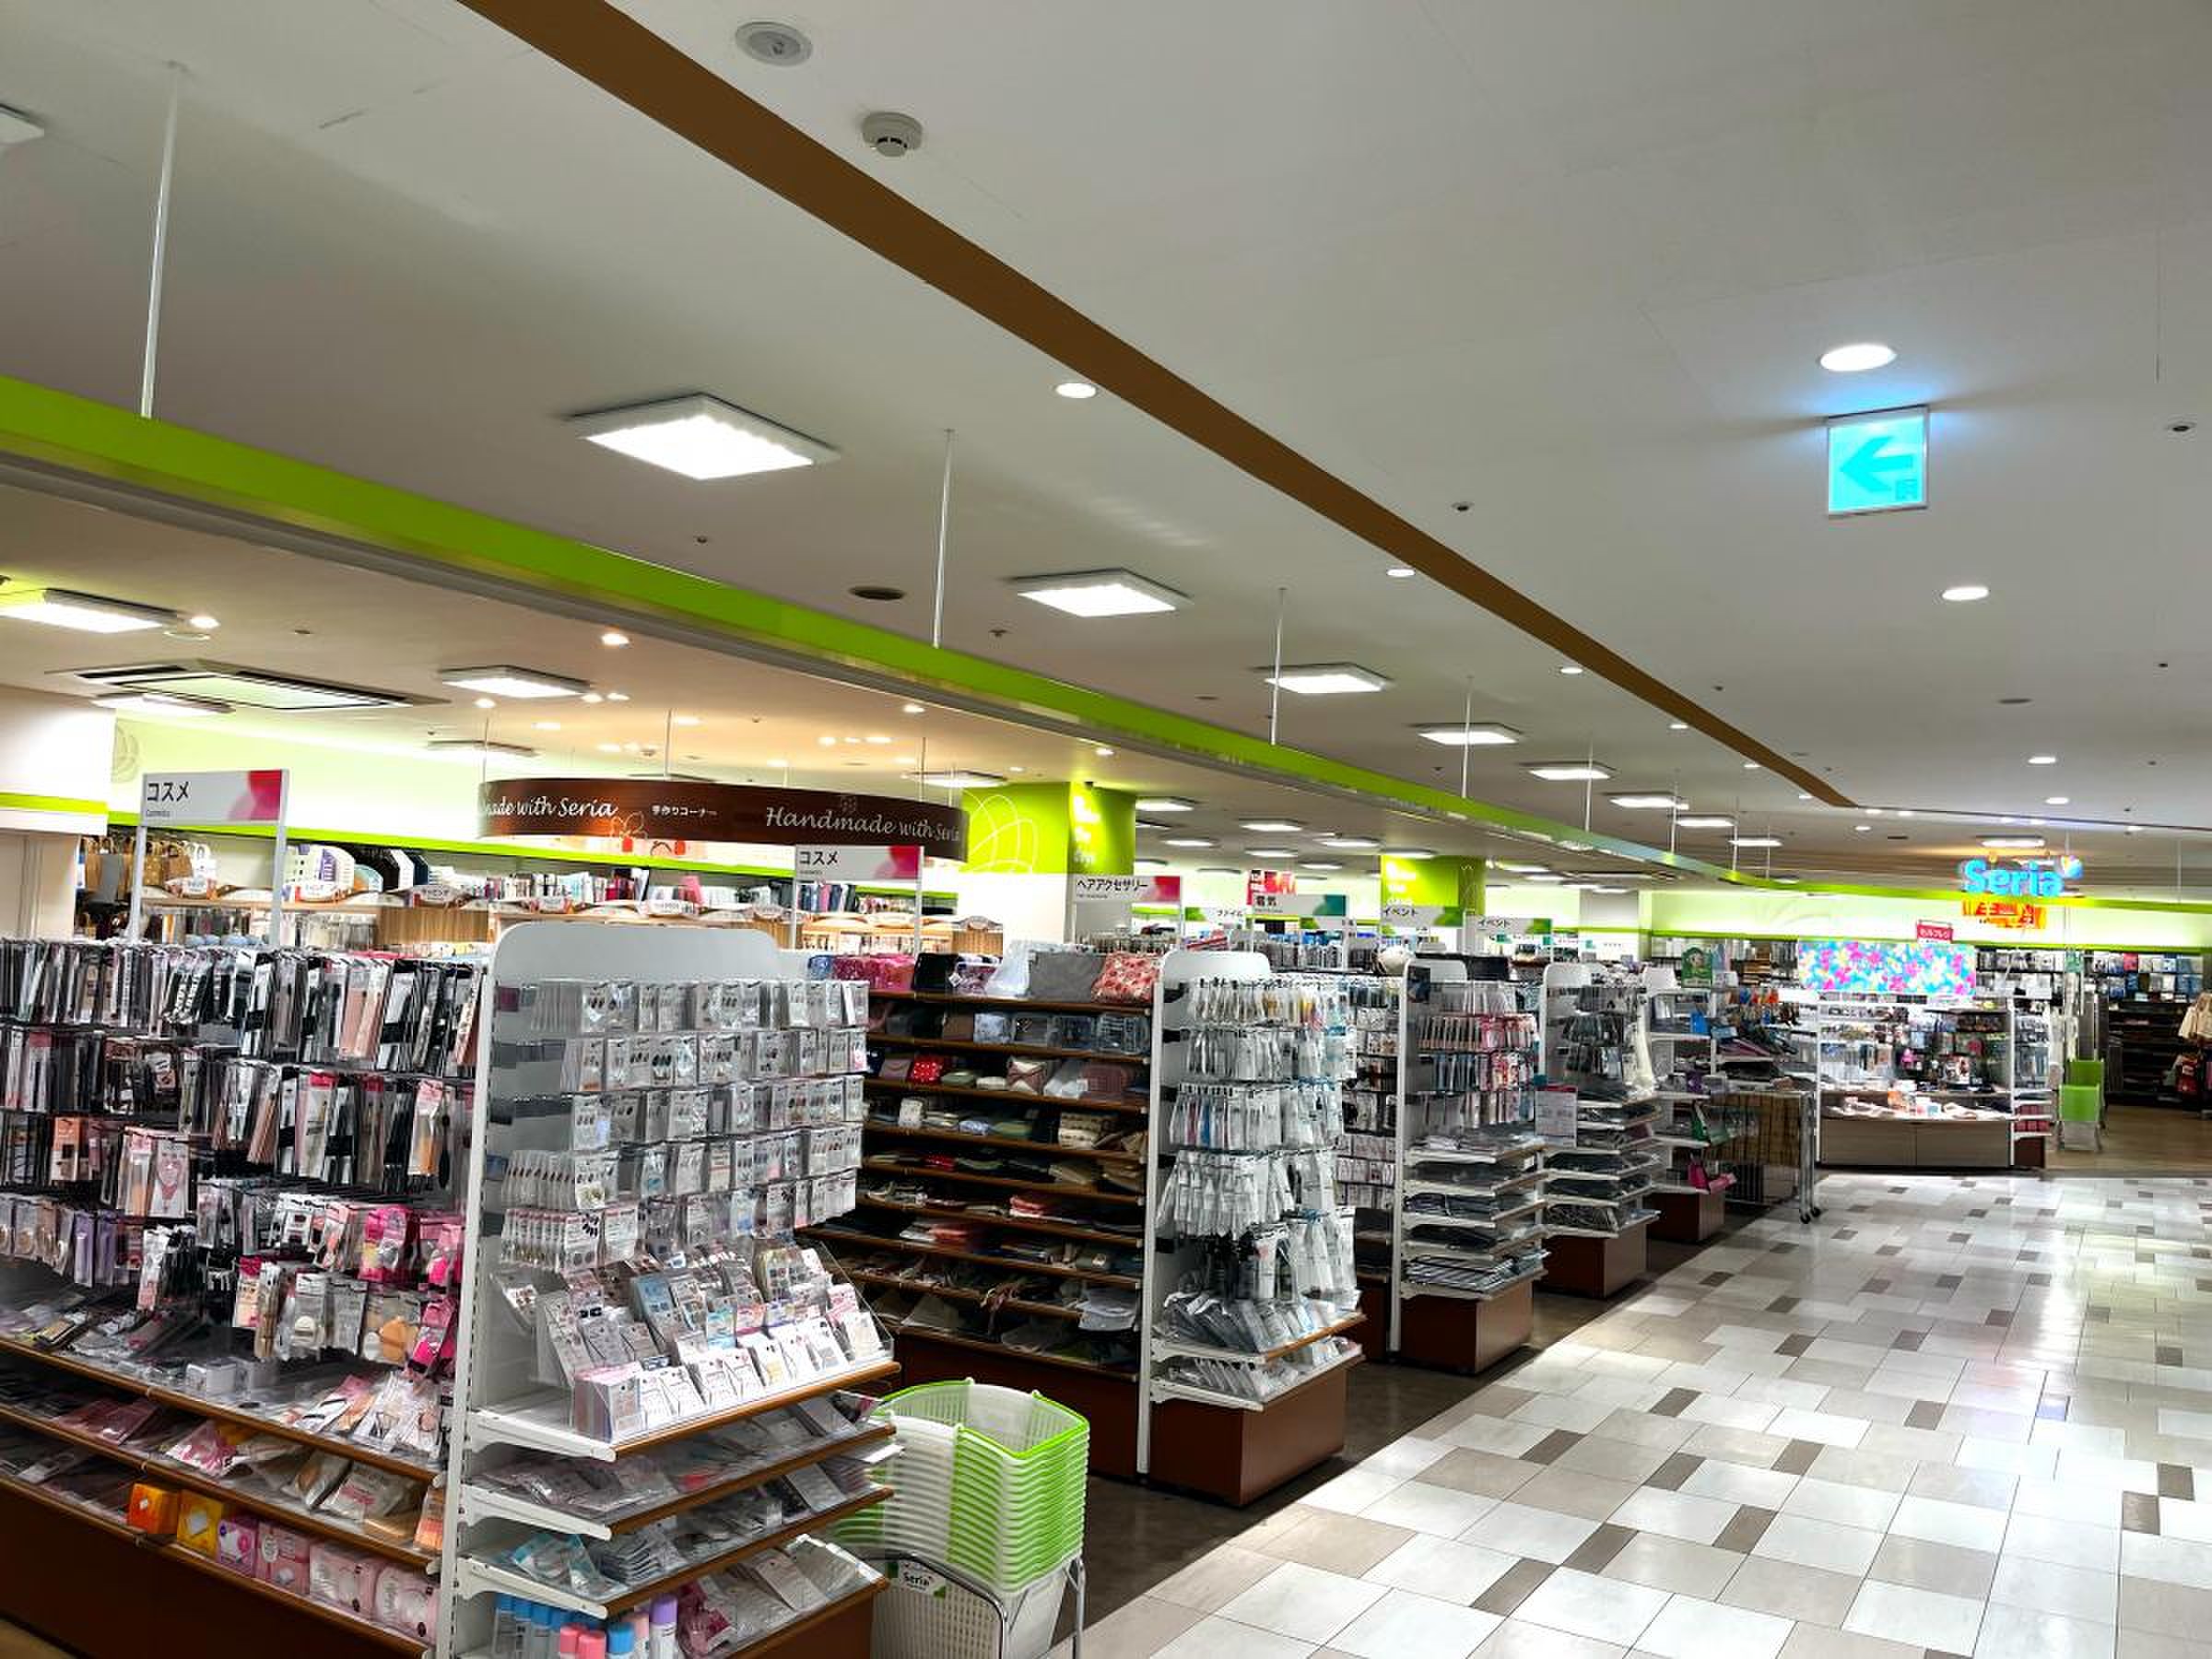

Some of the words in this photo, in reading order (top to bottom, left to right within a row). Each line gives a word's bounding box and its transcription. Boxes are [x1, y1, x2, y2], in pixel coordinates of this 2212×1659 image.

[147, 781, 190, 802] コスメ
[516, 795, 555, 818] with
[558, 797, 618, 818] Seria
[766, 806, 898, 835] Handmade
[899, 819, 934, 840] with
[799, 851, 838, 865] コスメ
[1077, 878, 1147, 891] ヘアアクセサリー
[1964, 859, 2064, 897] Seria
[1384, 907, 1417, 917] イベント
[1479, 918, 1509, 927] イベント
[903, 1571, 930, 1586] Seria
